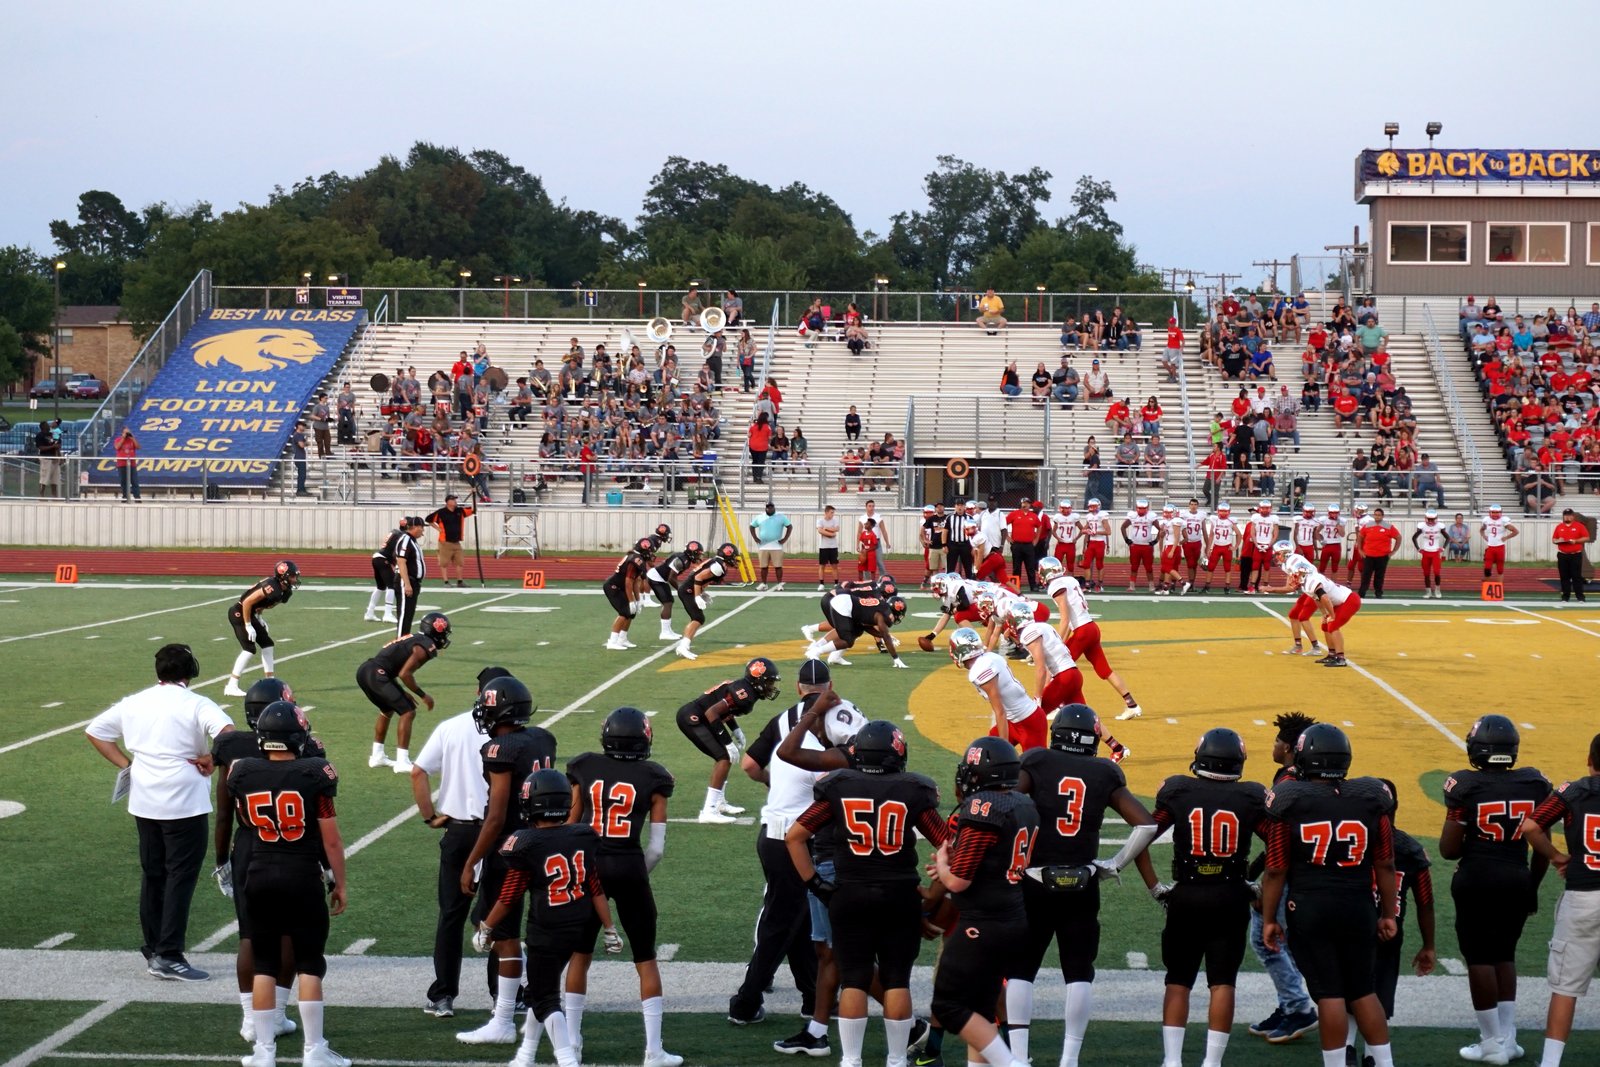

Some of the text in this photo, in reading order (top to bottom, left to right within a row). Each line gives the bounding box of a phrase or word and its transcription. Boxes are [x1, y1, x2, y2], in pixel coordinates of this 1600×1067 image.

[1407, 151, 1488, 177] BACK
[1490, 157, 1504, 170] to
[1507, 151, 1590, 177] BACK
[299, 294, 307, 303] H
[208, 308, 356, 322] BEST IN CLASS
[195, 380, 276, 393] LION
[140, 399, 300, 413] FOOTBALL
[140, 418, 284, 433] 23 TIME
[163, 438, 233, 452] LSC
[96, 458, 271, 473] CAMPIONS
[957, 478, 965, 496] 1
[1059, 525, 1074, 539] 24
[1133, 525, 1148, 538] 75
[1186, 522, 1201, 536] 59
[1214, 528, 1229, 540] 54
[1258, 525, 1271, 538] 14
[1325, 527, 1339, 539] 22
[1491, 526, 1497, 538] 9
[1428, 534, 1435, 547] 5
[59, 566, 73, 581] 10
[525, 572, 542, 587] 20
[1486, 584, 1502, 599] 40
[966, 747, 983, 765] 64
[1061, 745, 1085, 753] Riddell
[589, 779, 637, 838] 12
[970, 798, 992, 817] 64
[1056, 776, 1087, 837] 3
[246, 790, 306, 842] 58
[1477, 800, 1536, 842] 57
[841, 797, 908, 856] 50
[1188, 807, 1240, 858] 10
[1300, 820, 1368, 867] 73
[544, 850, 586, 907] 21
